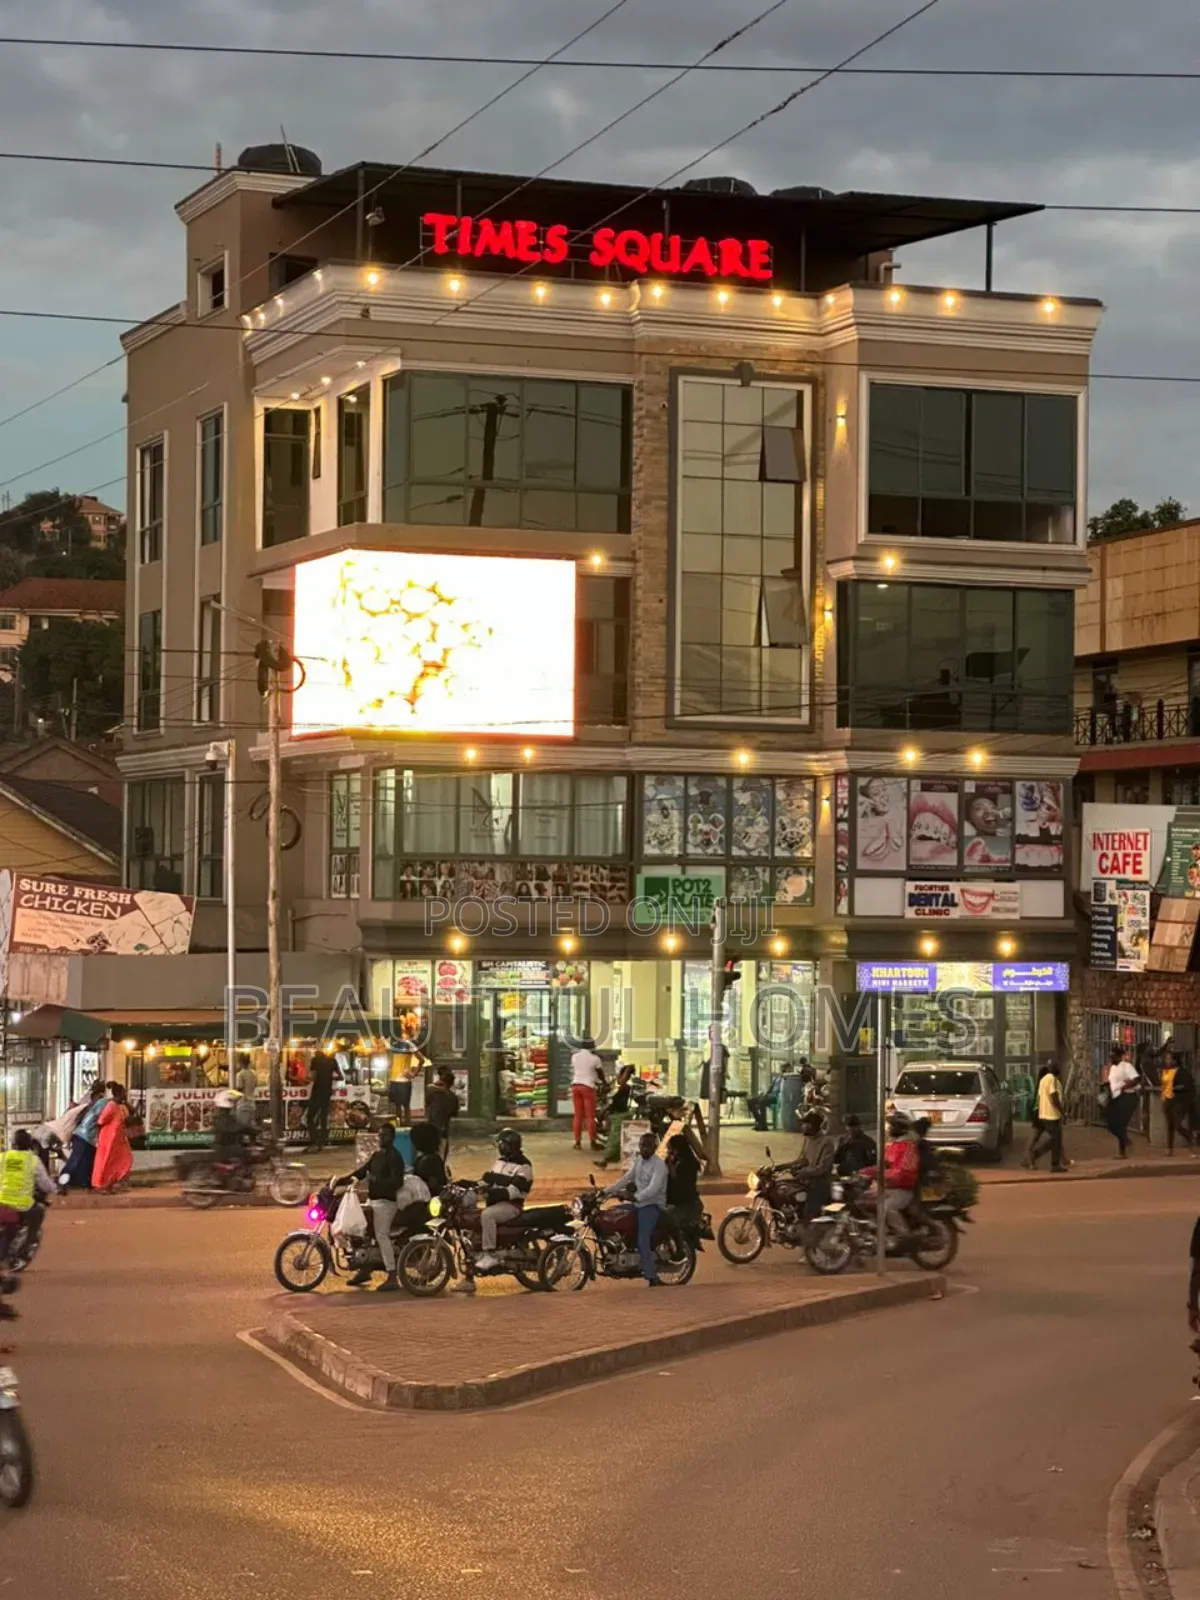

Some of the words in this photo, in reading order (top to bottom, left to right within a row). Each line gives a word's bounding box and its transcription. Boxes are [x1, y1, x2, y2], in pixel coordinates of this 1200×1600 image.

[424, 212, 569, 264] TIMES
[590, 228, 773, 279] SQUARE
[1092, 832, 1149, 851] INTERNET
[1098, 852, 1142, 875] CAFE
[19, 878, 69, 896] SURE
[73, 886, 132, 905] FRESH
[908, 893, 959, 907] DENTAL
[19, 894, 122, 919] CHICKEN
[914, 908, 950, 916] CLINIC
